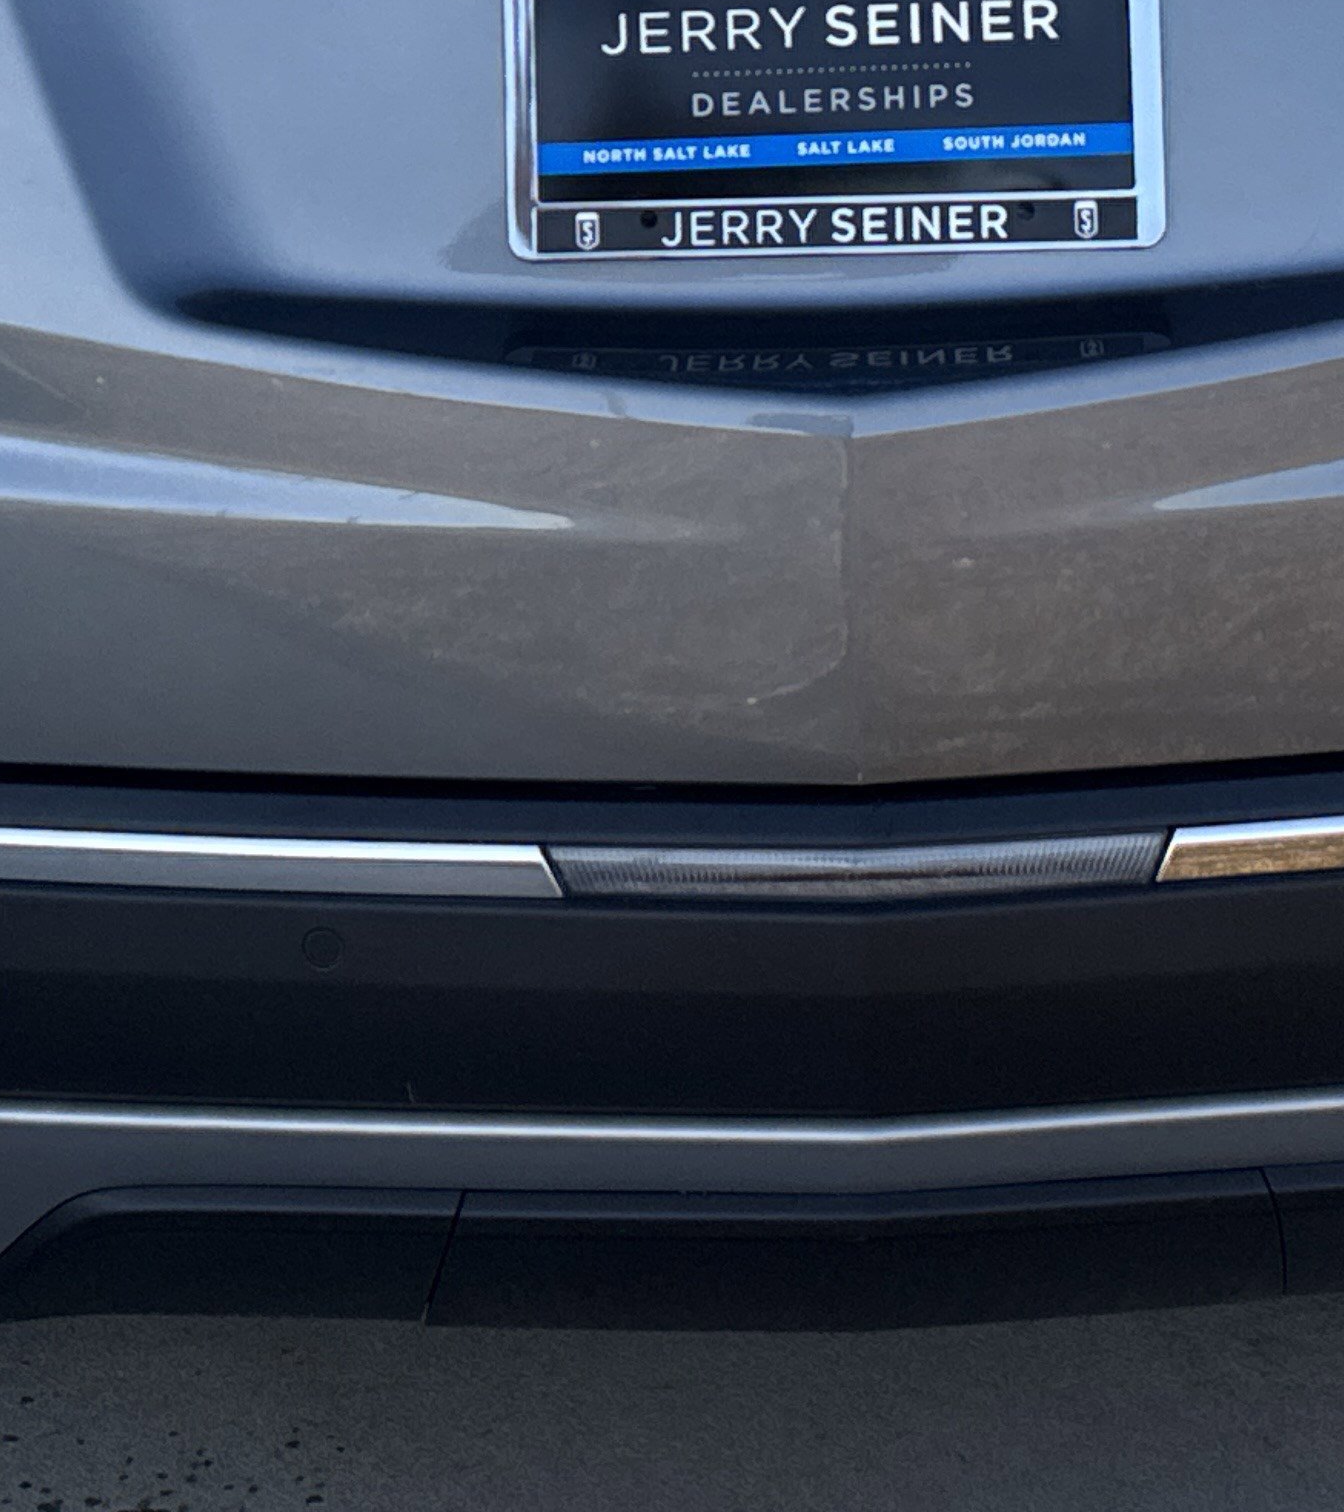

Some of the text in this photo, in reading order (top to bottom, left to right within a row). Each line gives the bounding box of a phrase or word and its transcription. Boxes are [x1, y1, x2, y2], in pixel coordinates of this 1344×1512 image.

[601, 6, 806, 55] JERRY
[692, 83, 974, 118] DEALERSHIPS
[583, 144, 751, 164] NORTH SALT LAKE
[797, 138, 895, 156] SALT LAKE
[942, 132, 1086, 151] SOUTH JORDAN
[661, 204, 1009, 247] JERRY SEINER
